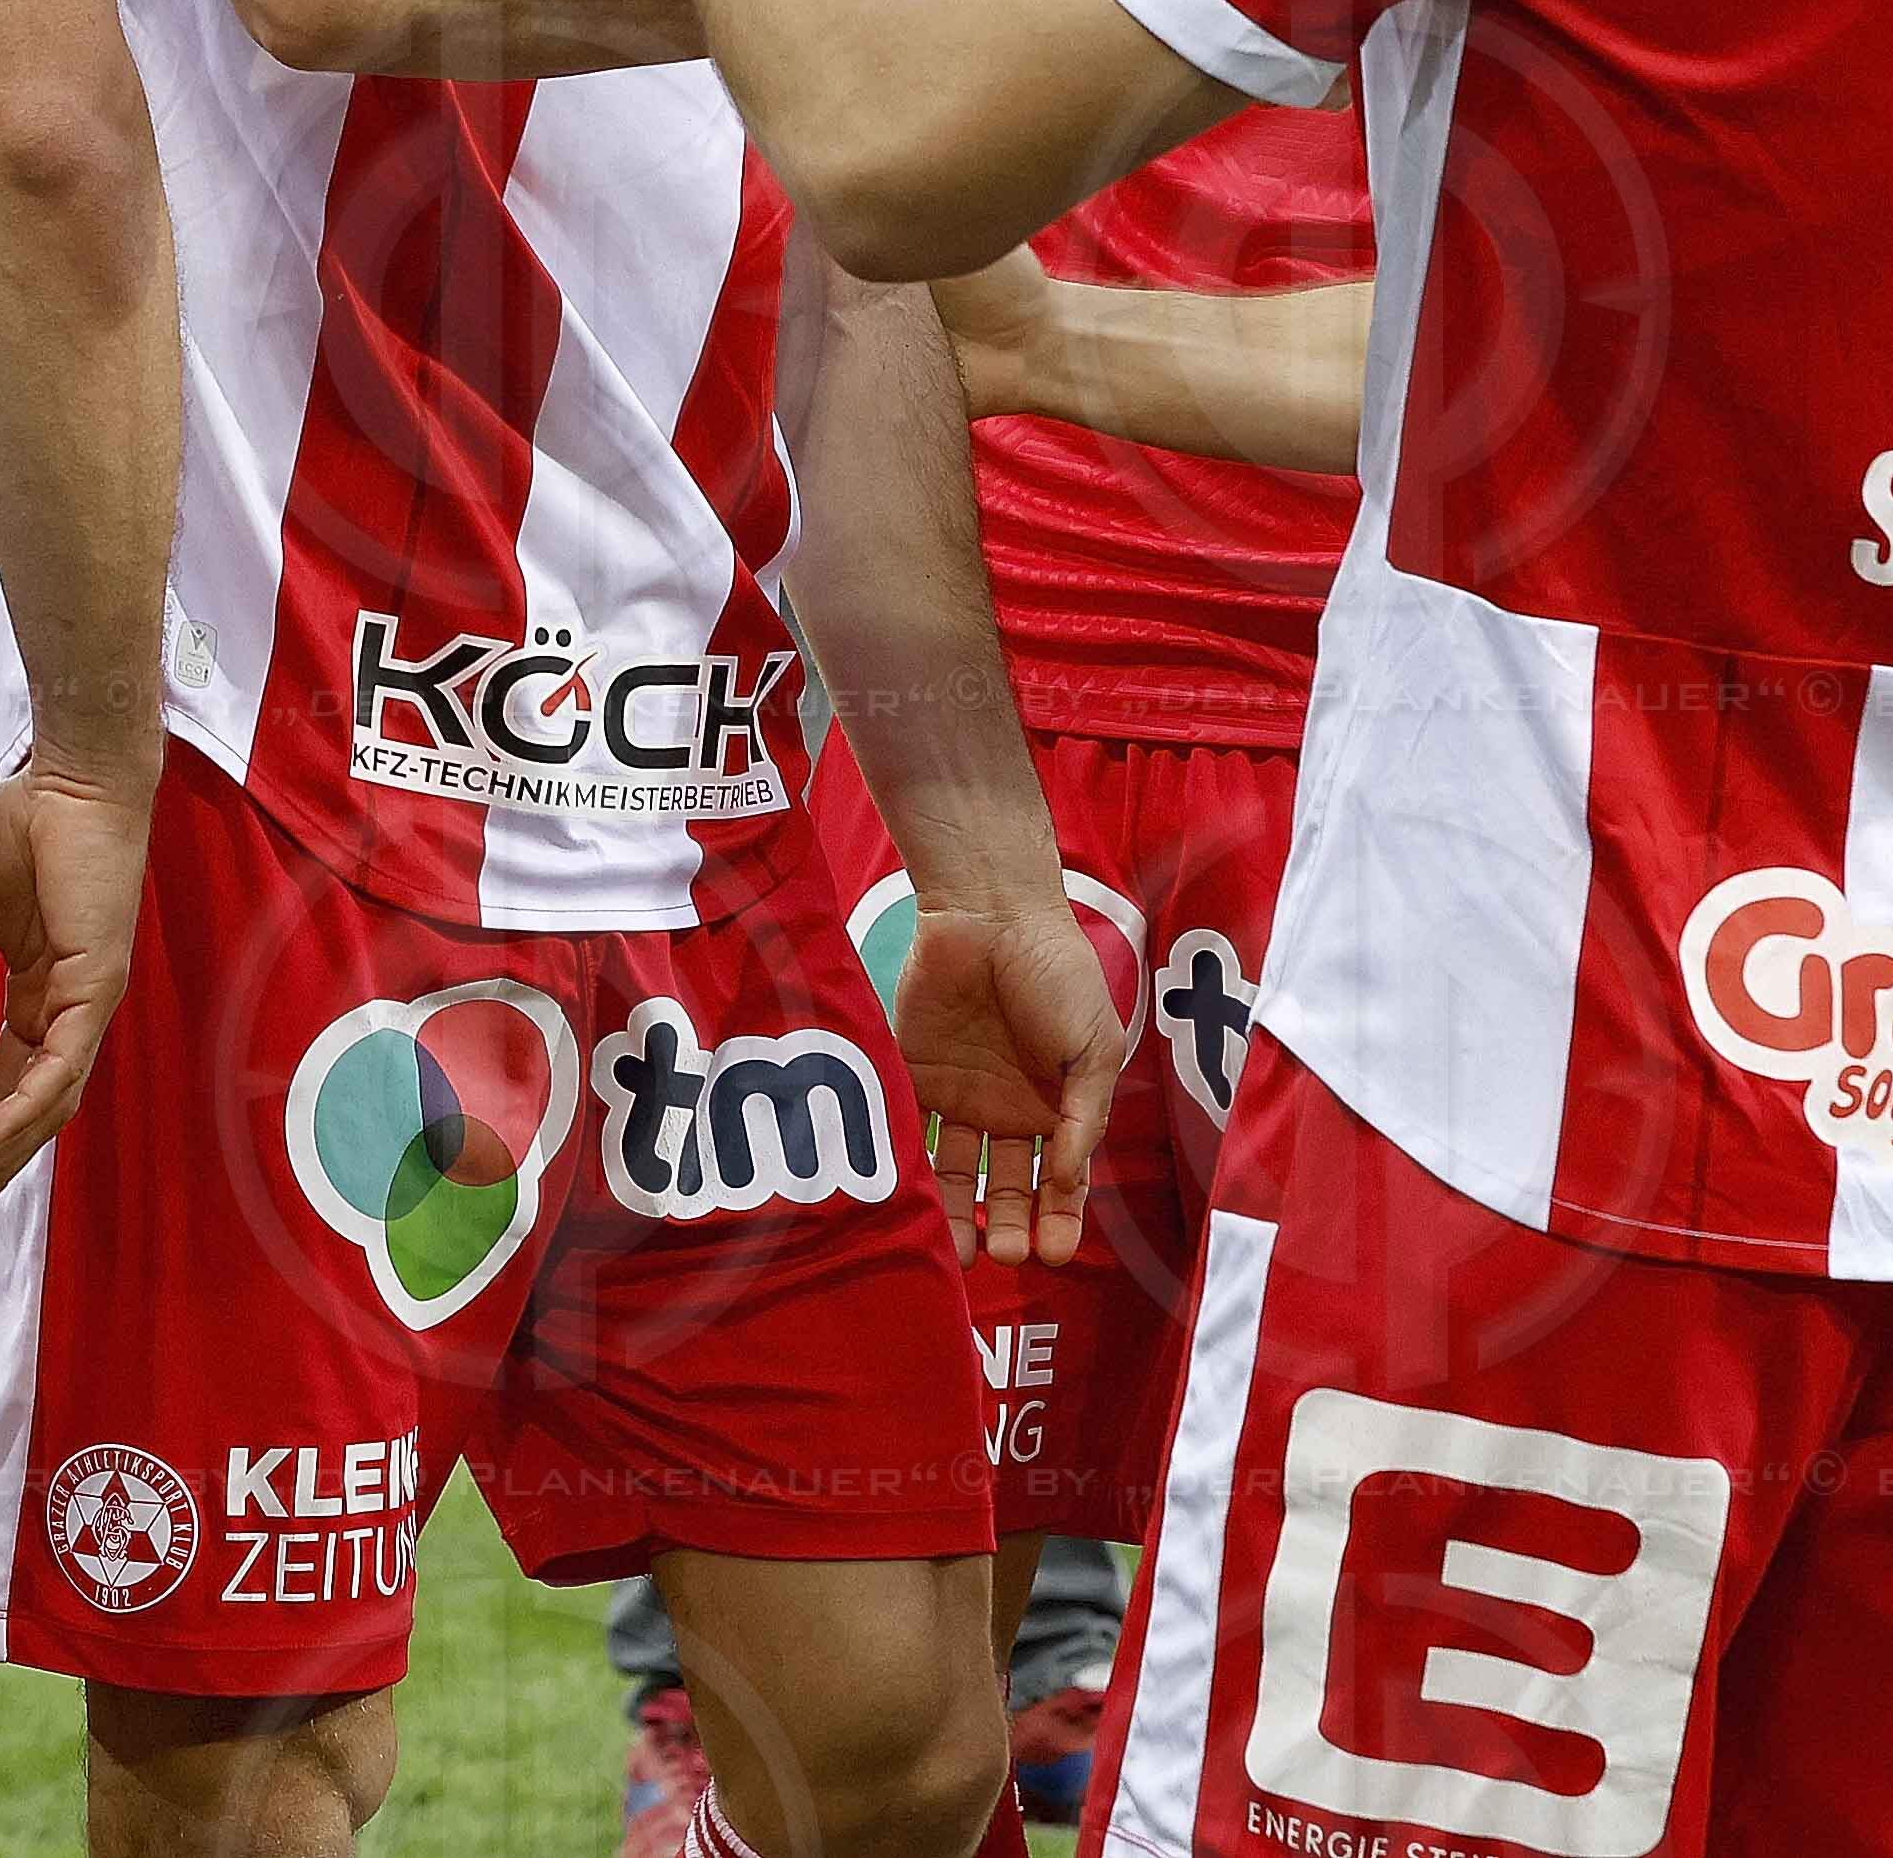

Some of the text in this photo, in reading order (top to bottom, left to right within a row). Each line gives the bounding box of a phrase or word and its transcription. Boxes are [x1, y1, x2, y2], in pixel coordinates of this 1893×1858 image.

[355, 620, 785, 771] KÖCK
[51, 1450, 193, 1570] GRAZER ATHLETIKSPORT KLUB
[221, 1509, 417, 1603] ZEITUN
[94, 1584, 132, 1607] 1902
[1246, 1800, 1390, 1858] ENERGIE
